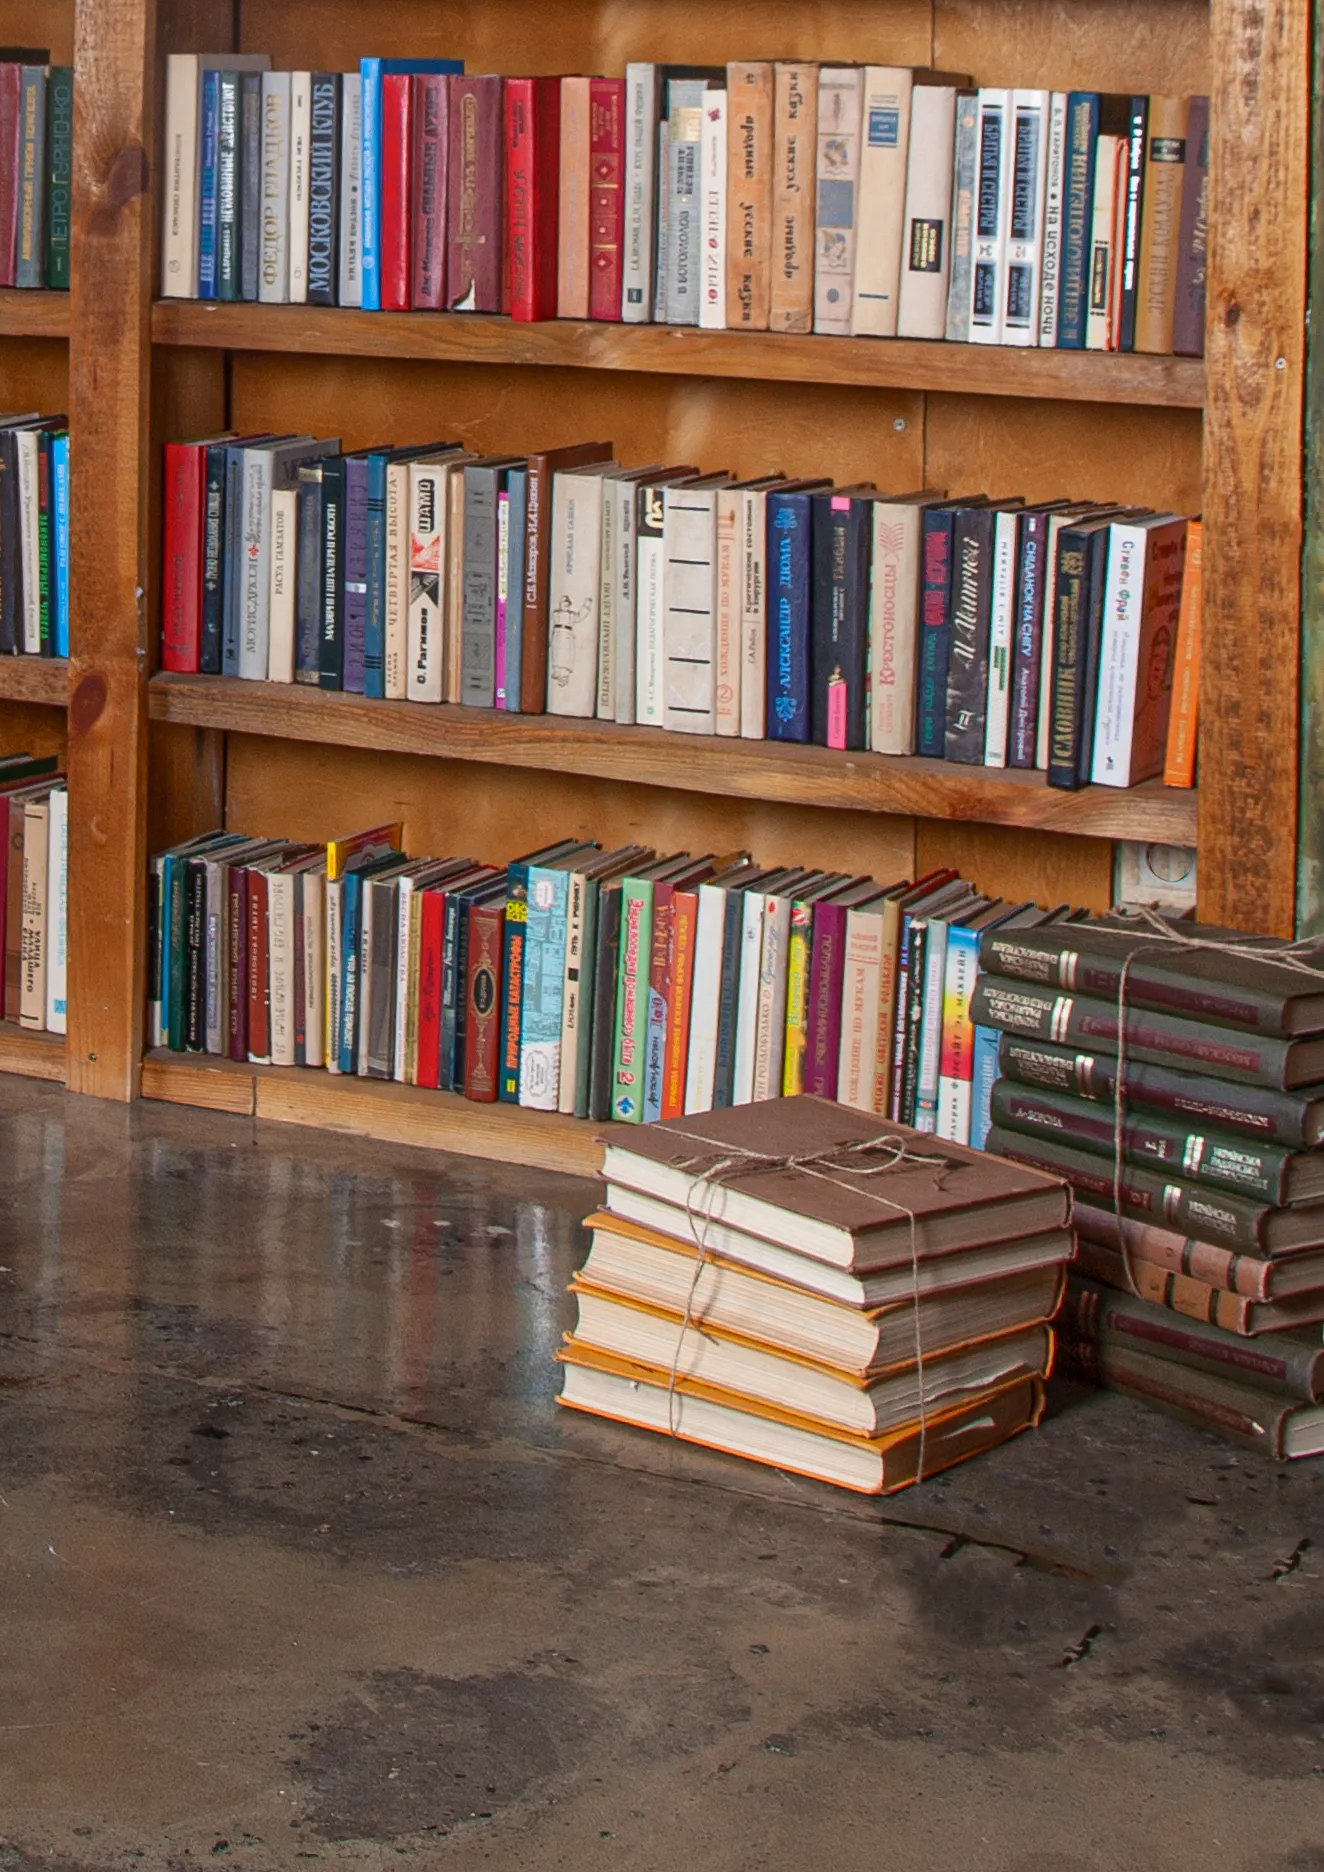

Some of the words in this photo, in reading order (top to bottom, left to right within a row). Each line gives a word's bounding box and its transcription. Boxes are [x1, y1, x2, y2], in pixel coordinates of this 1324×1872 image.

[313, 83, 332, 135] КЛУБ
[266, 94, 283, 200] ГЛАДКОВ
[308, 141, 332, 292] МОСКОВСКИЙ
[40, 515, 48, 596] ЗАКОНОМЕРНЫЕ
[779, 538, 792, 588] ДЮМА
[40, 602, 48, 639] ЧУДЕСА
[778, 598, 792, 687] АЛЕКСАНДР
[508, 936, 521, 1003] КАТАСТРОФЫ
[854, 969, 864, 1012] МУКАМ
[506, 1005, 519, 1068] ПРИРОДНЫЕ
[853, 1018, 861, 1033] ПО
[618, 1071, 635, 1085] 2
